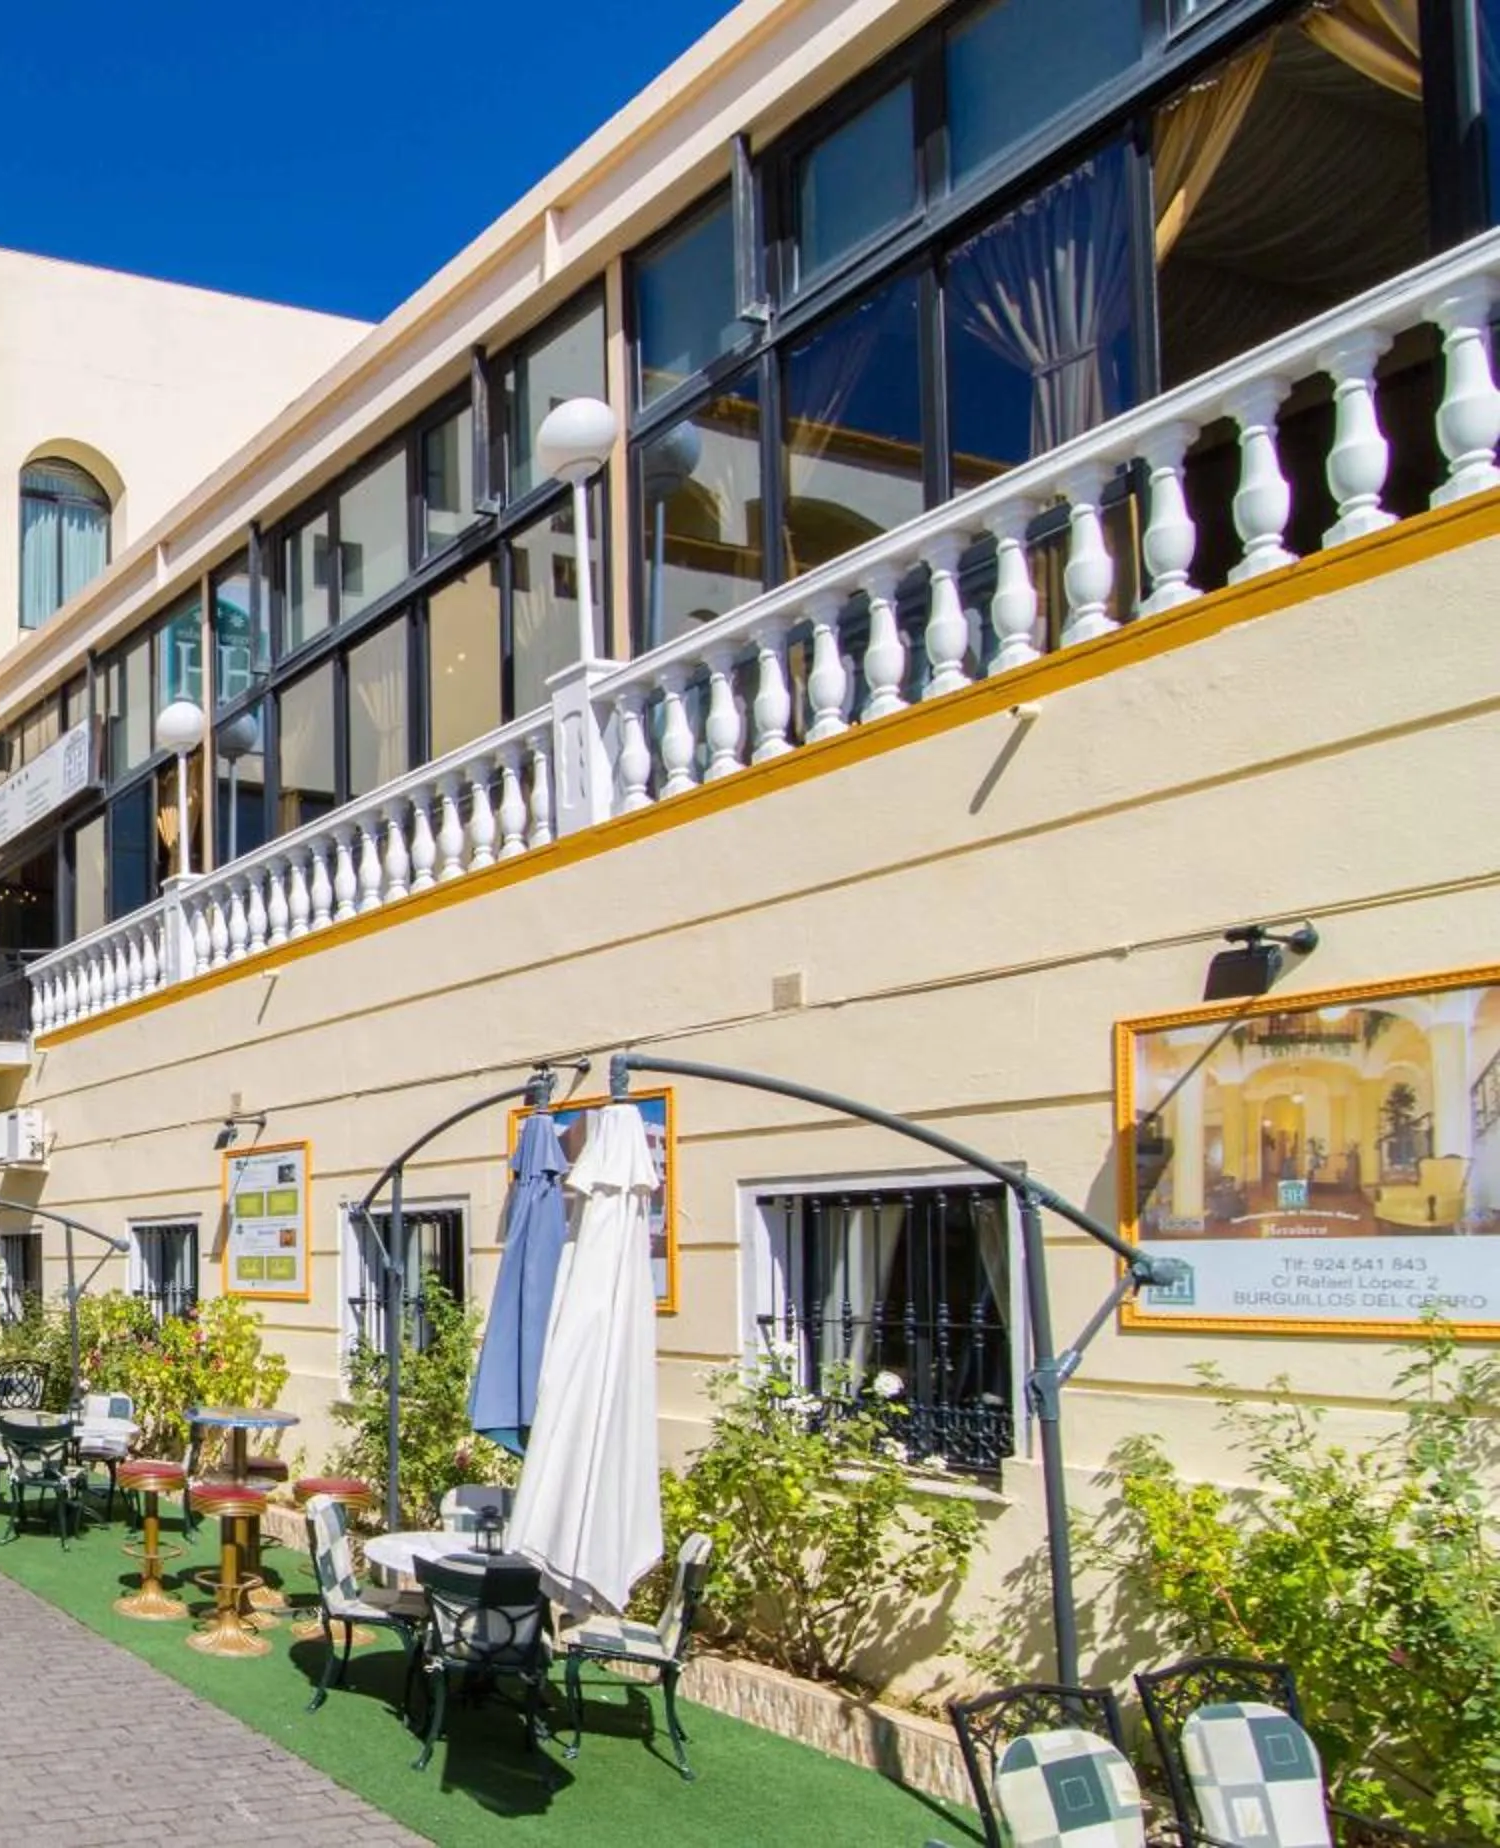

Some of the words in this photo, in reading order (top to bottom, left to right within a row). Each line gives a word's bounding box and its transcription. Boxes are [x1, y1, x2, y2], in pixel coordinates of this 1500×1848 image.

[1312, 1256, 1346, 1271] 924
[1352, 1257, 1385, 1271] 541
[1391, 1257, 1428, 1271] 843
[1296, 1274, 1353, 1289] Rafael
[1426, 1275, 1440, 1290] 2
[1233, 1290, 1358, 1307] BURGUILLOS
[1361, 1292, 1400, 1307] DEL
